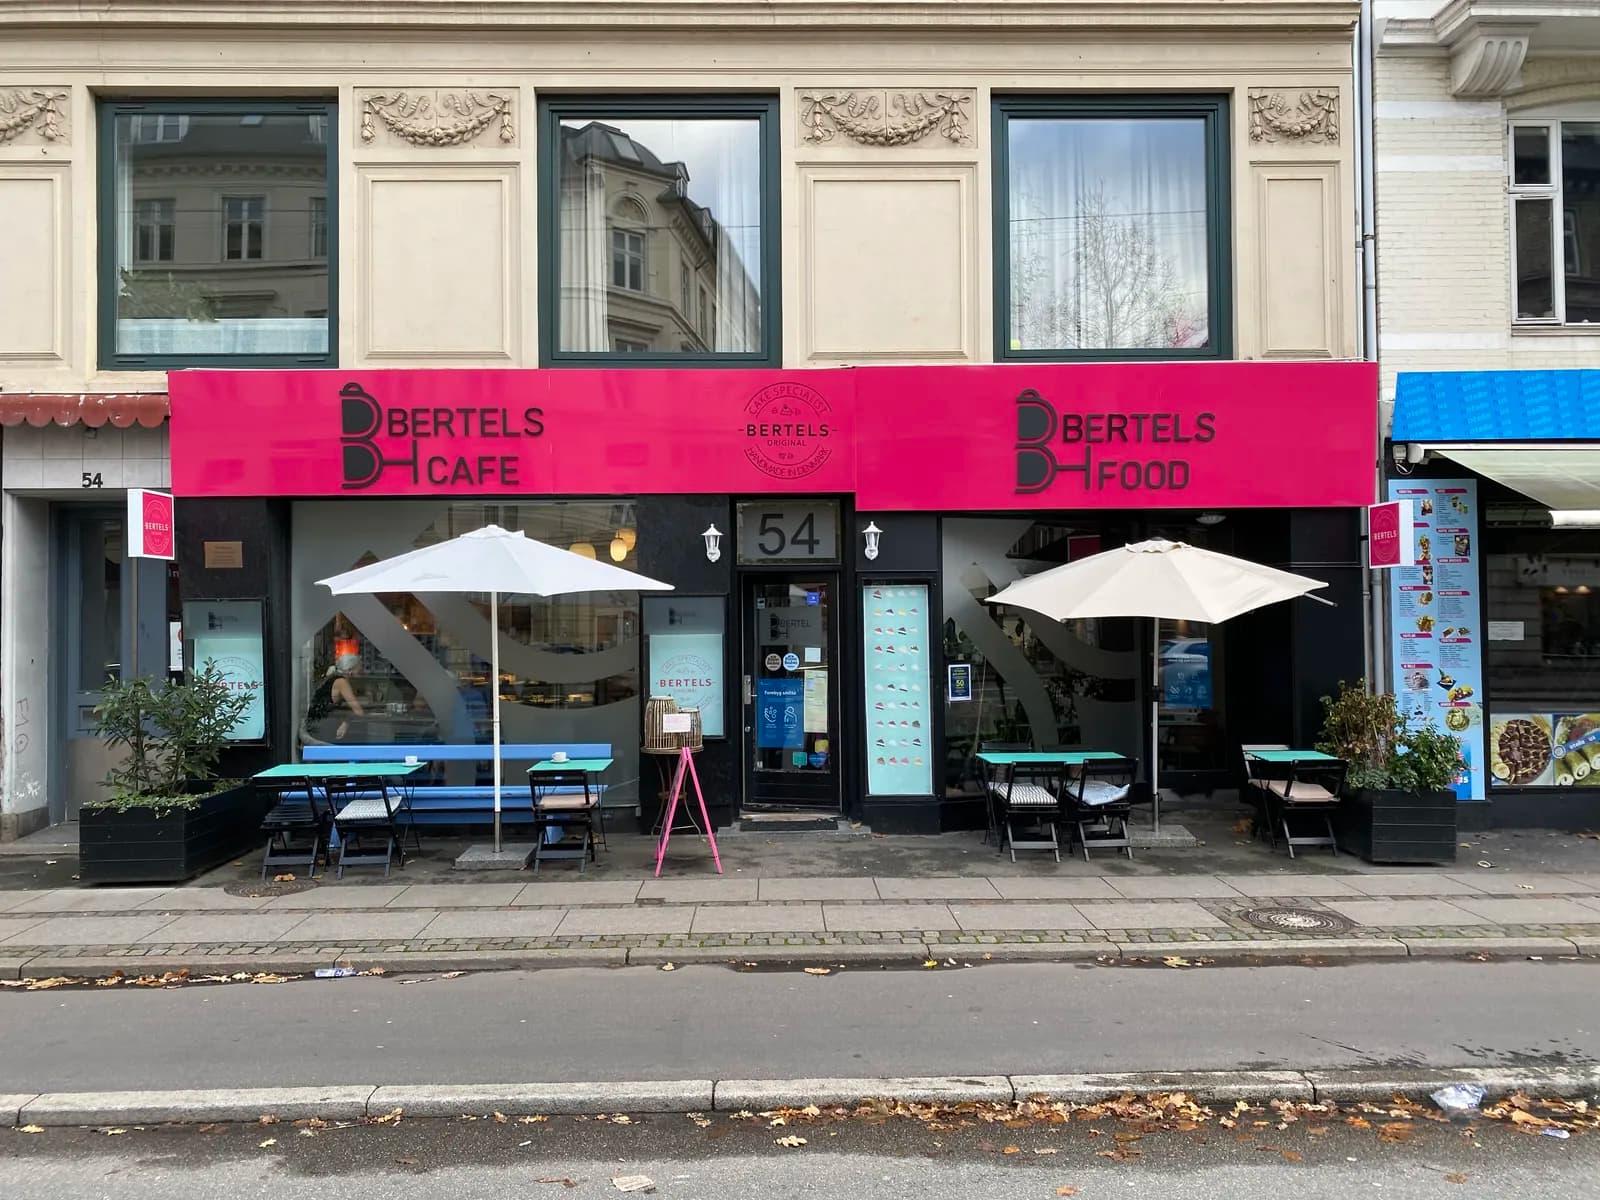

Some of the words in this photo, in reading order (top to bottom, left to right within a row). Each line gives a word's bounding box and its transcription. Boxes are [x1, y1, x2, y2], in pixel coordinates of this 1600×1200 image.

[748, 391, 772, 415] CAKE
[773, 385, 828, 414] SPECIALIST
[388, 408, 544, 437] BERTELS
[746, 424, 829, 437] BERTELS
[1062, 413, 1216, 443] BERTELS
[82, 472, 103, 488] 54
[427, 456, 520, 485] CAFE
[1098, 460, 1190, 490] FOOD
[144, 522, 168, 531] BERTELS
[759, 512, 820, 555] 54
[1374, 530, 1397, 541] BERTELS
[659, 678, 712, 688] BERTELS
